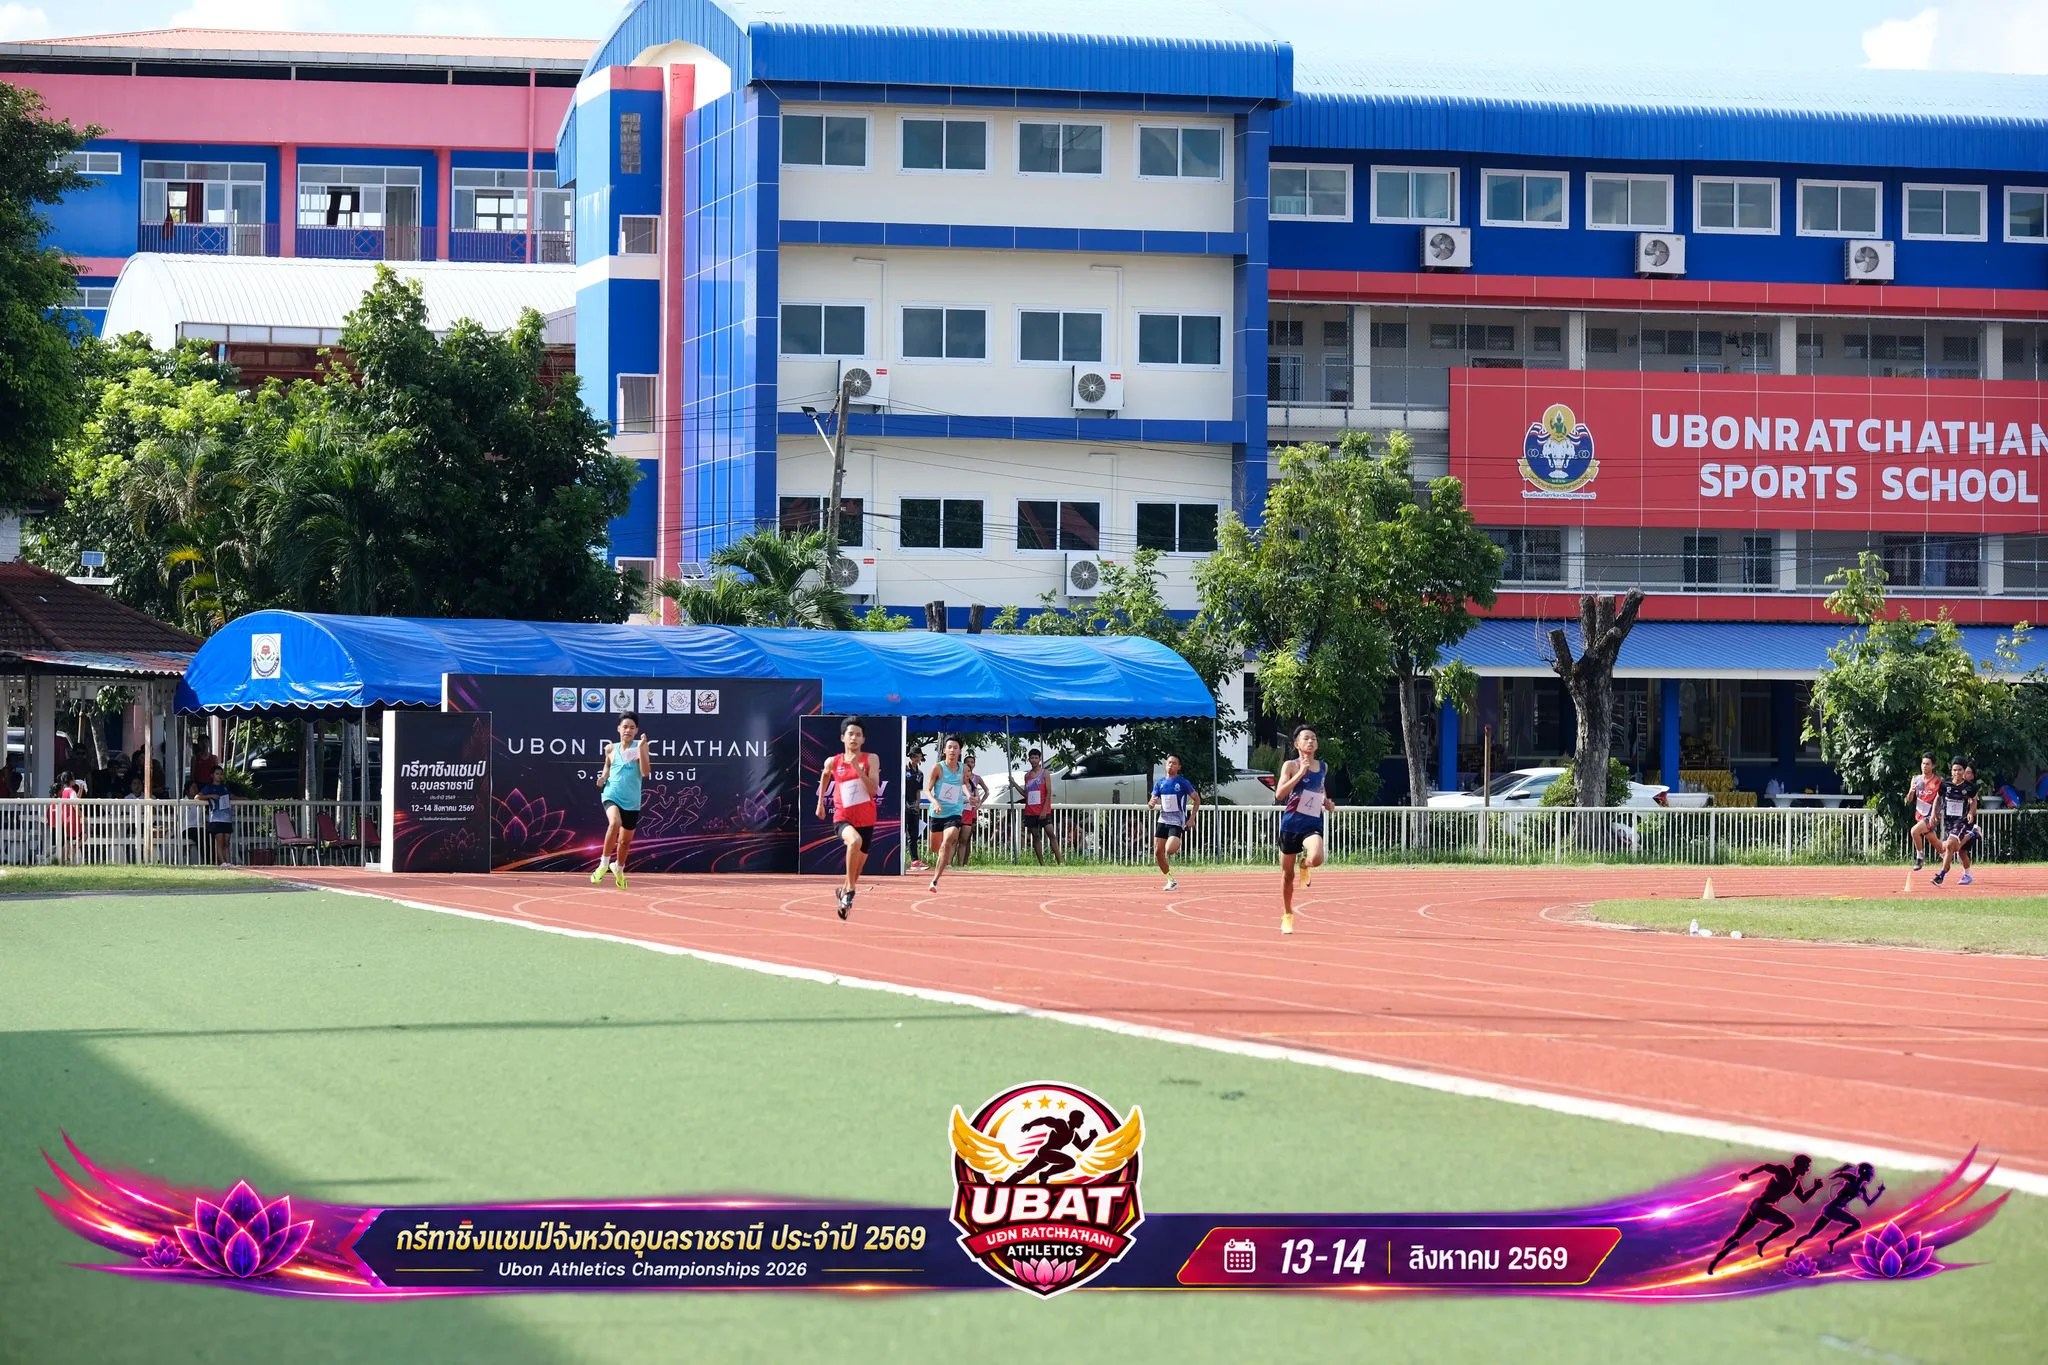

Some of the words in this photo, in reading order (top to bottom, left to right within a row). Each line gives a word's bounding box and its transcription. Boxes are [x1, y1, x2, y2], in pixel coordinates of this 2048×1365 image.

[1699, 462, 1858, 500] SPORTS
[1881, 466, 2039, 503] SCHOOL
[507, 738, 586, 755] UBON
[599, 738, 767, 757] RCHATHANI
[433, 803, 457, 812] สิงหาคม
[458, 804, 475, 812] 2569
[1304, 796, 1314, 811] 4
